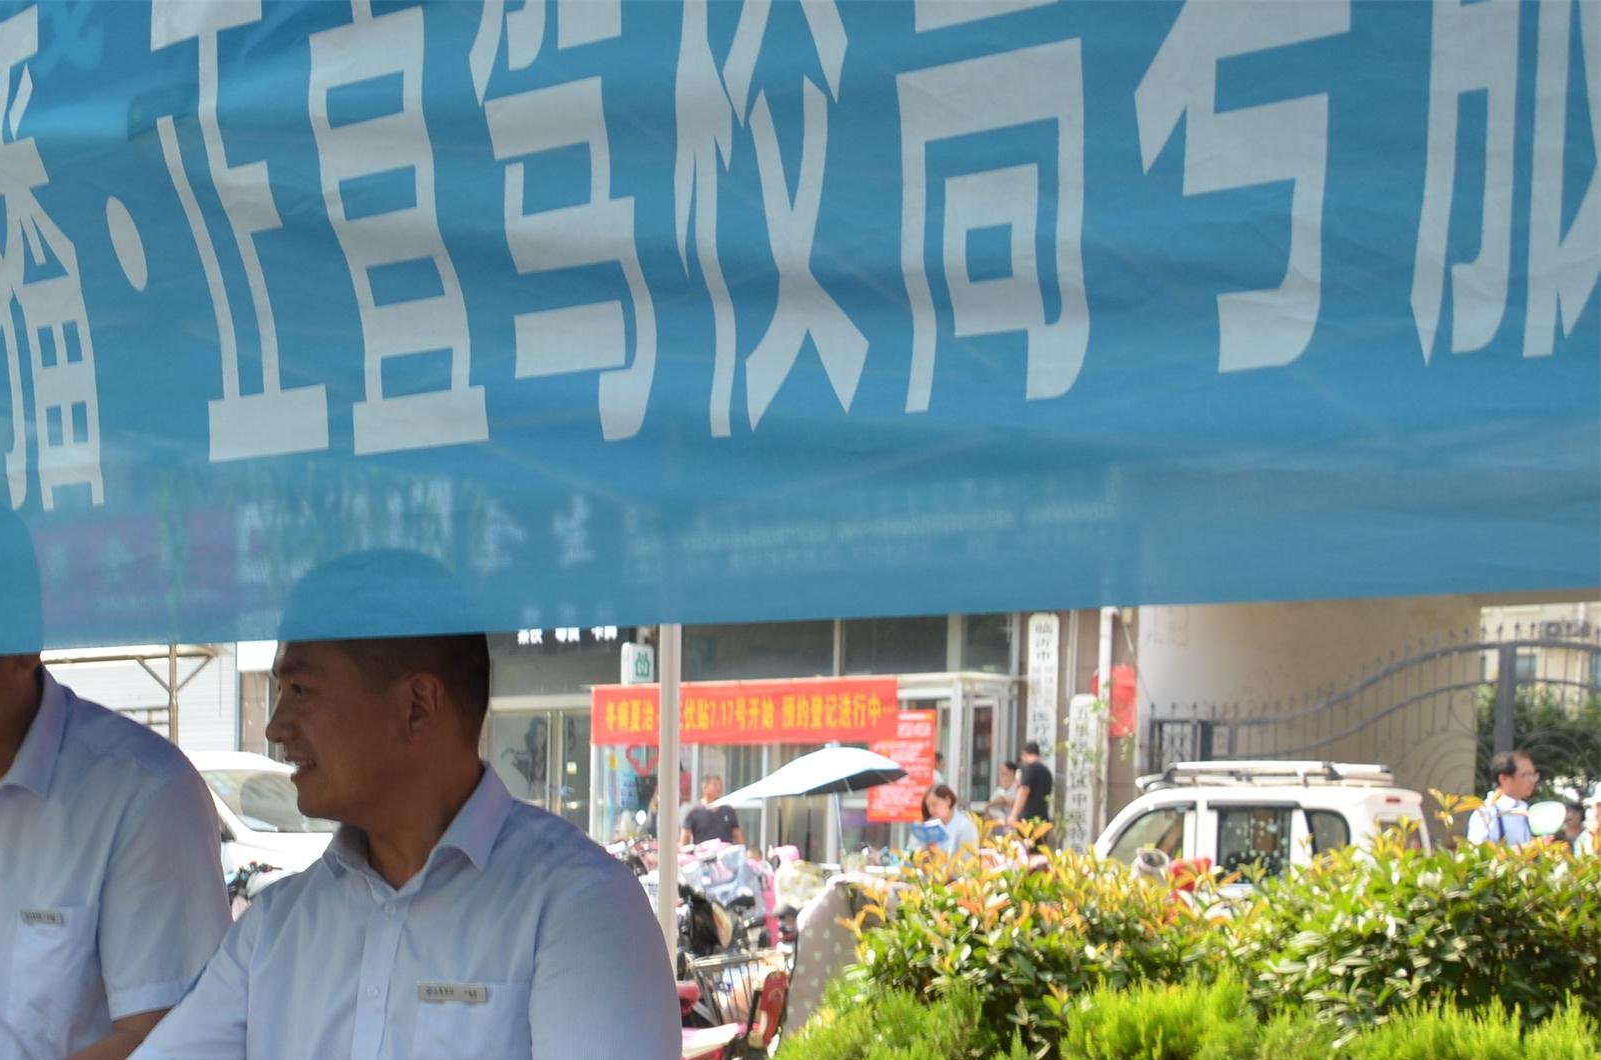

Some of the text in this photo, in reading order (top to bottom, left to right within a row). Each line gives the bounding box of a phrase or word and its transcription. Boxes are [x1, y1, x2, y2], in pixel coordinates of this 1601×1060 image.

[680, 696, 774, 731] 伏贴7.17号开始
